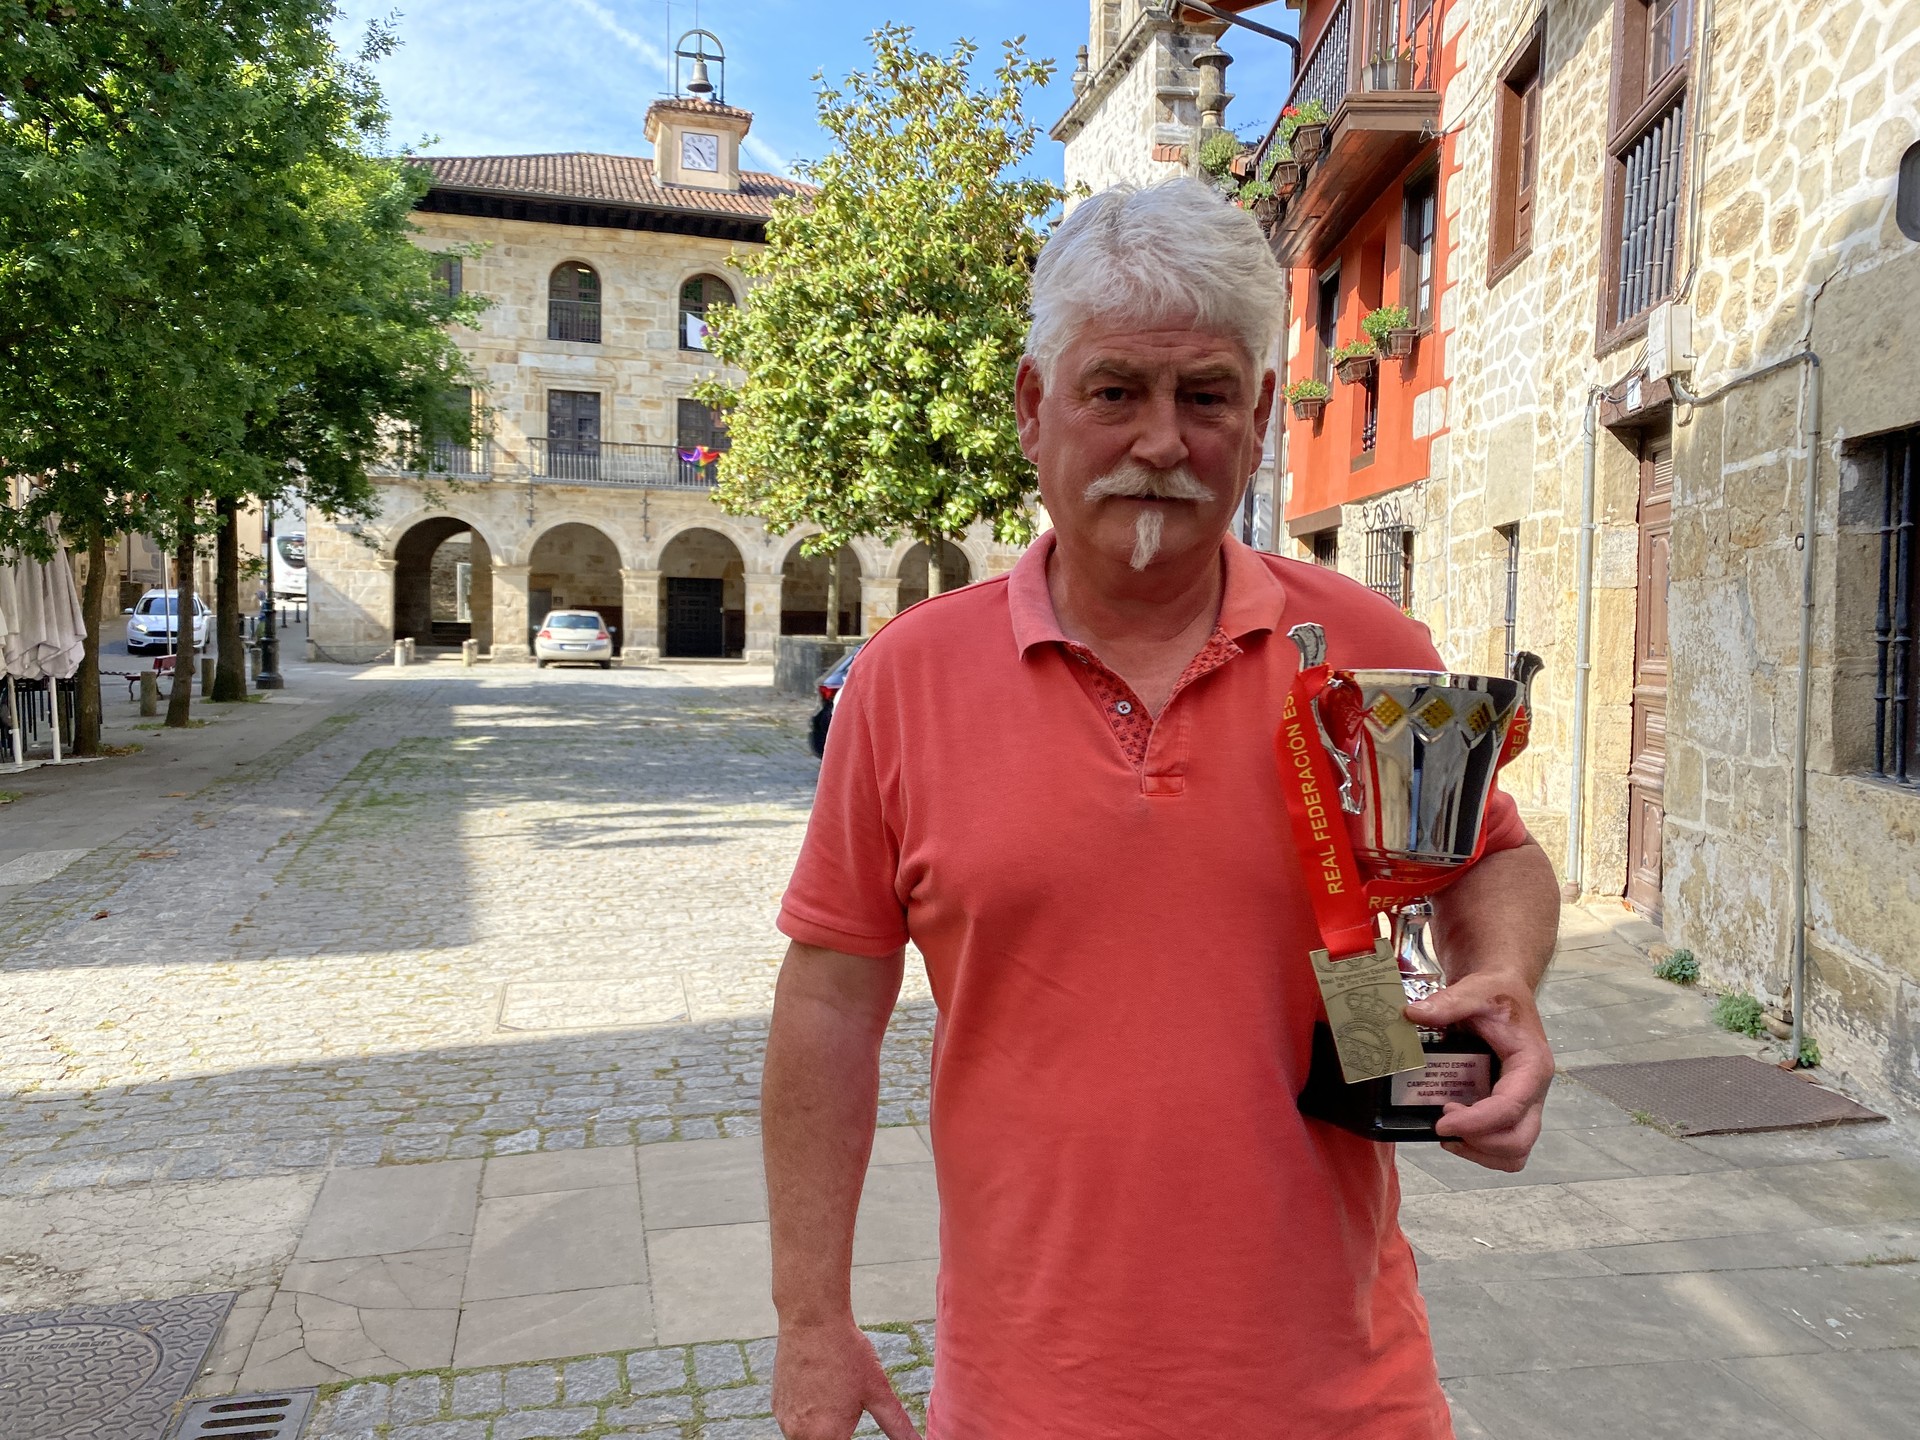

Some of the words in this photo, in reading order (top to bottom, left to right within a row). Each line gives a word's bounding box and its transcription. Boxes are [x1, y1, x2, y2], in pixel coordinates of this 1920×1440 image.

[1510, 711, 1530, 757] REAL
[1285, 722, 1330, 842] FEDERACIÓN
[1321, 844, 1345, 895] REAL
